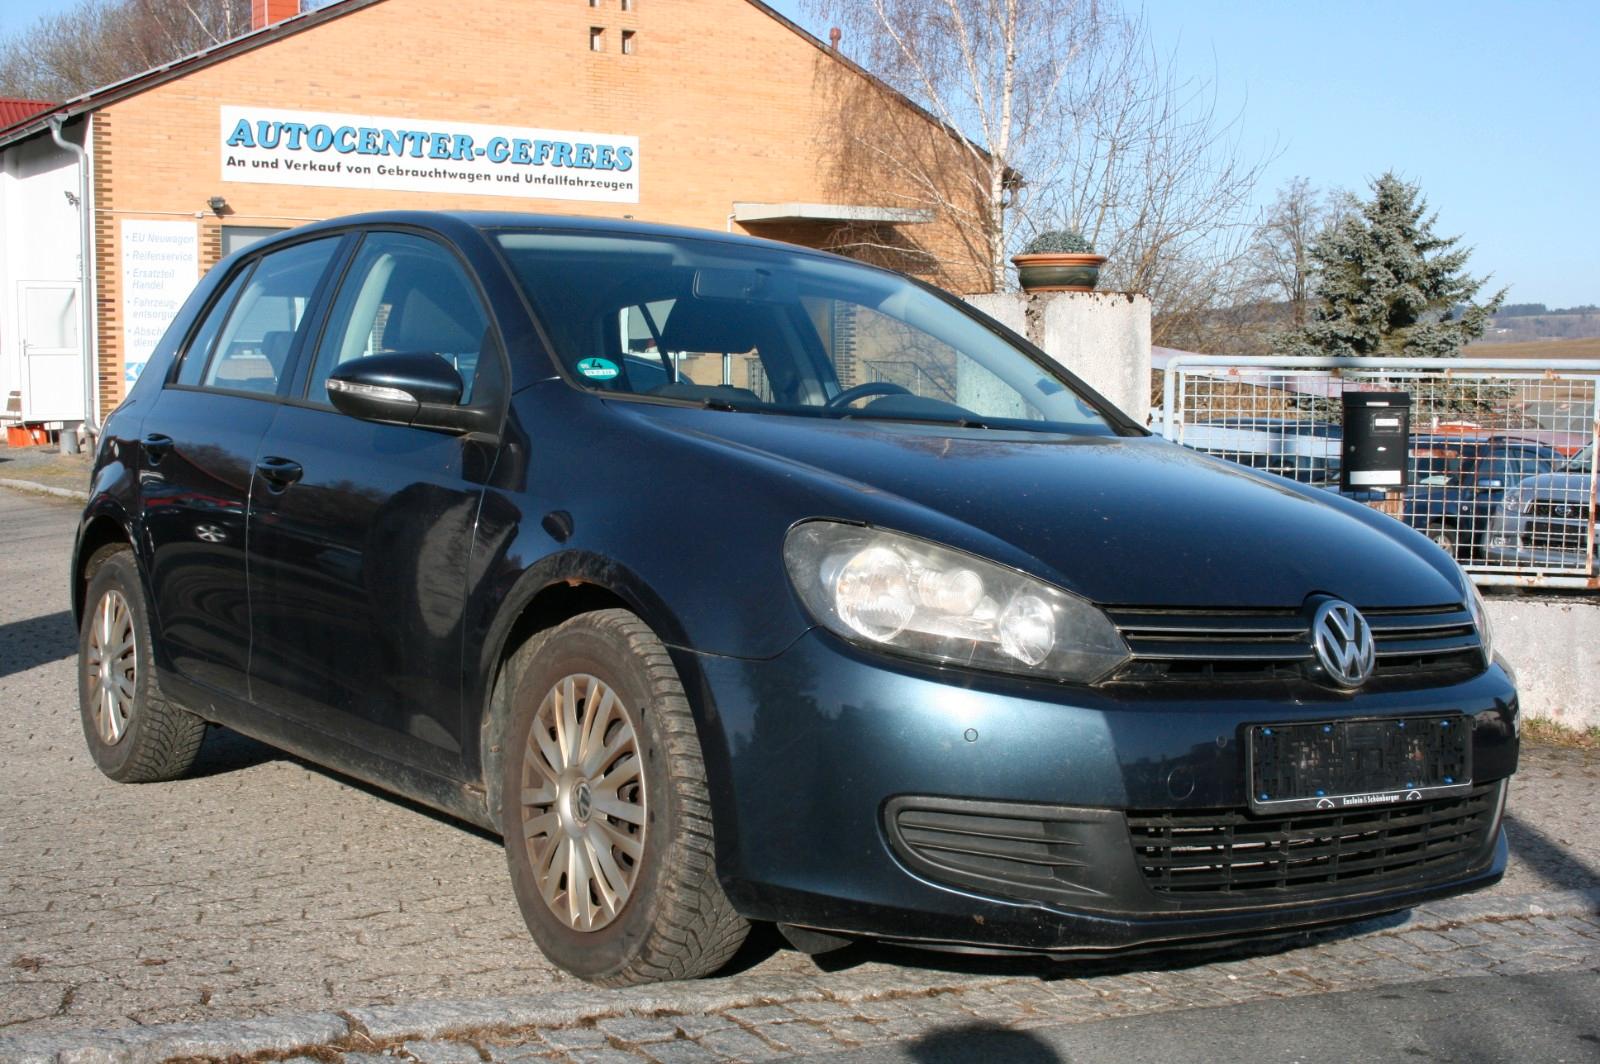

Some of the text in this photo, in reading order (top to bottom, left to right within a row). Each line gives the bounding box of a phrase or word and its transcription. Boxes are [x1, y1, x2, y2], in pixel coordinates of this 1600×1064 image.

[226, 118, 634, 172] AUTOCENTER-GEFREES
[226, 156, 634, 191] An und Verkauf von Gebrauchtwagen und Unfallfahrzeugen
[131, 232, 194, 246] EU Neuwagen
[132, 250, 193, 262] Reifenservice
[132, 268, 175, 279] Ersatzteil
[132, 279, 164, 290] Handel
[591, 358, 603, 369] 4
